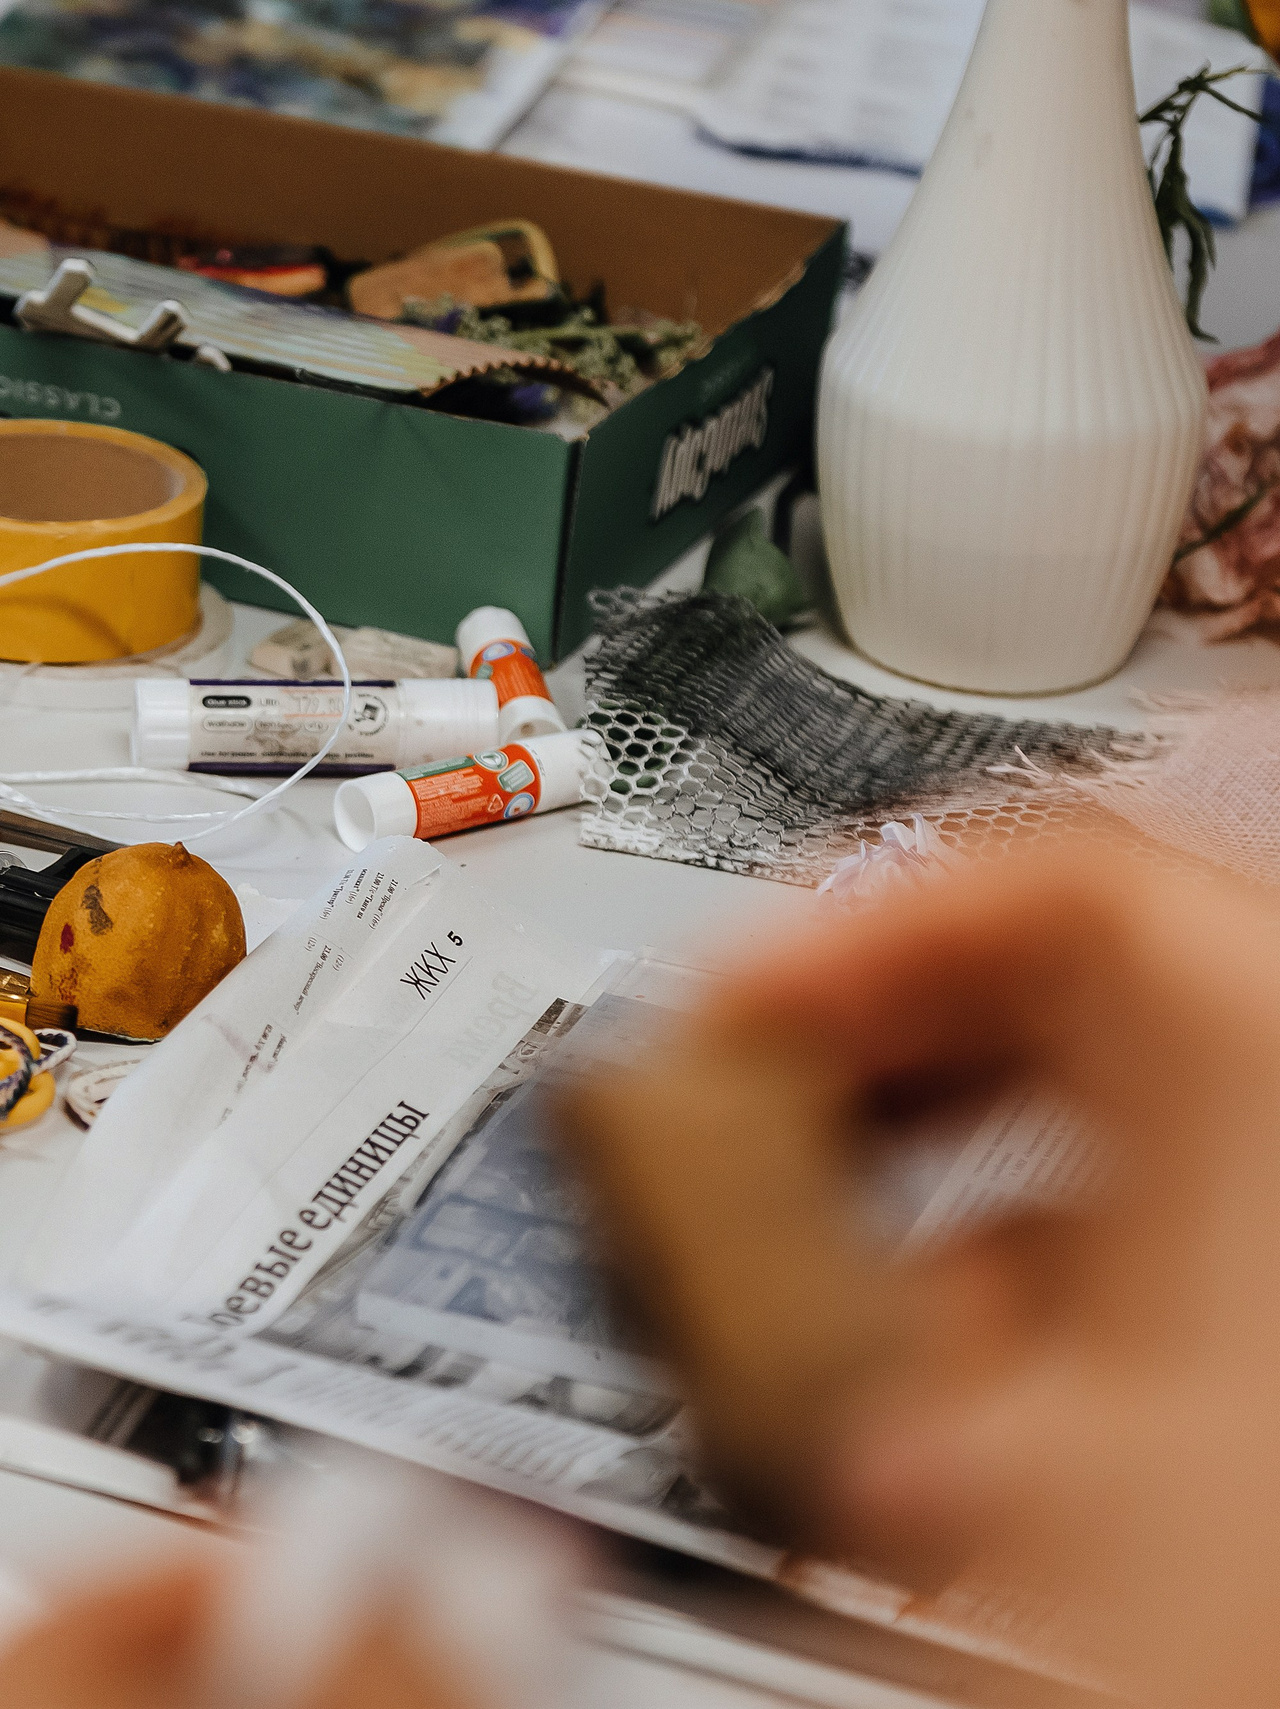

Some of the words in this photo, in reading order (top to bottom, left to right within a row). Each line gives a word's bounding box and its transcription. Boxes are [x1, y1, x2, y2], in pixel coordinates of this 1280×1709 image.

[387, 879, 399, 895] 21.00
[344, 891, 358, 905] (16+)
[319, 907, 333, 920] (16+)
[368, 913, 381, 930] (16+)
[303, 936, 317, 952] (12+)
[332, 954, 345, 972] (12+)
[399, 941, 456, 1000] ЖКХ
[447, 930, 464, 947] 5
[298, 1100, 431, 1231] единицы
